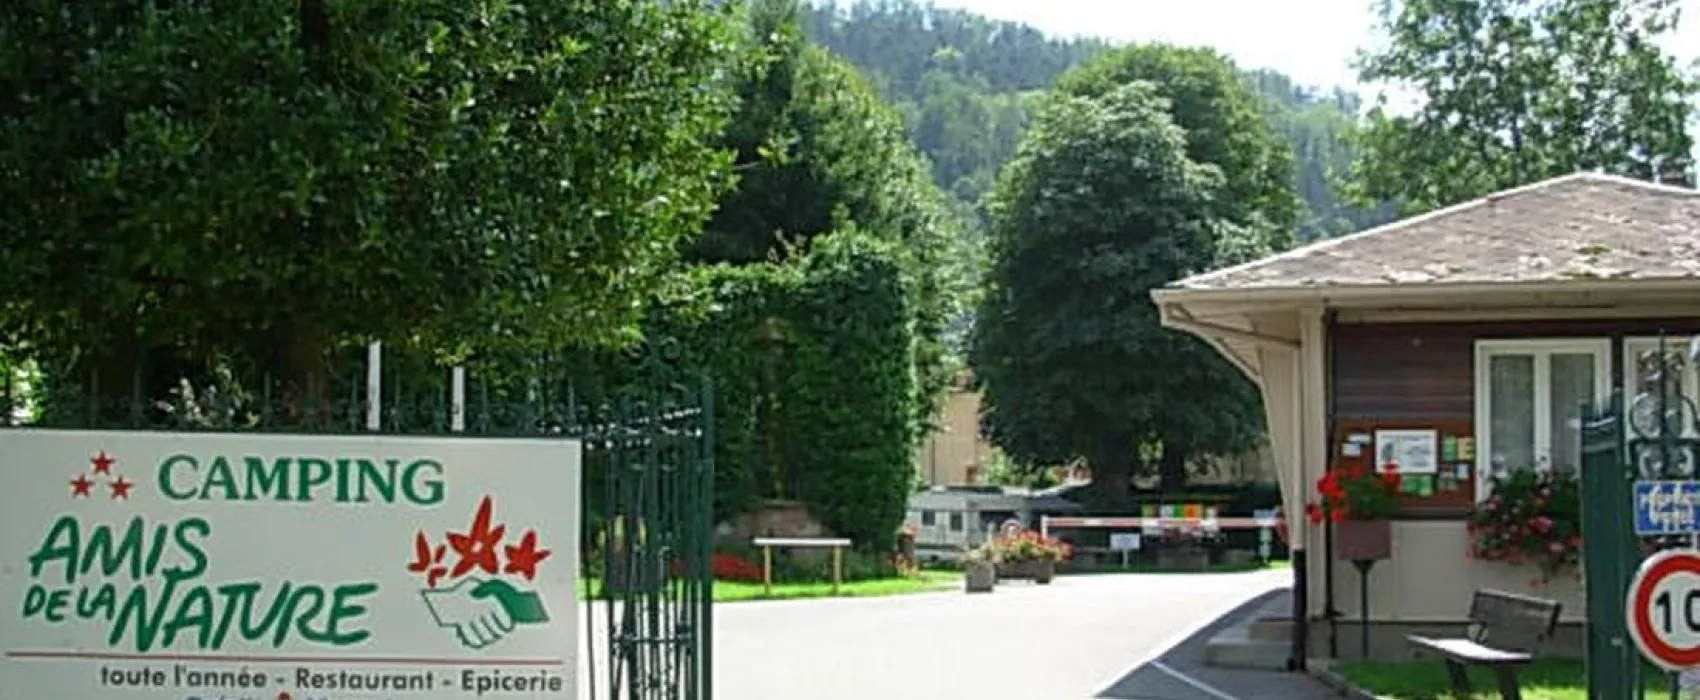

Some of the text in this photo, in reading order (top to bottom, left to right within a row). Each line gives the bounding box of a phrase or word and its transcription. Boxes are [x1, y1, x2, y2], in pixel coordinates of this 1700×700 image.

[158, 454, 446, 505] CAMPING
[28, 515, 210, 582] AMIS
[23, 566, 378, 652] DE LA NATURE
[102, 666, 166, 686] toute
[175, 664, 267, 688] l'année
[296, 668, 433, 691] Restaurant
[461, 670, 562, 696] Epicerie
